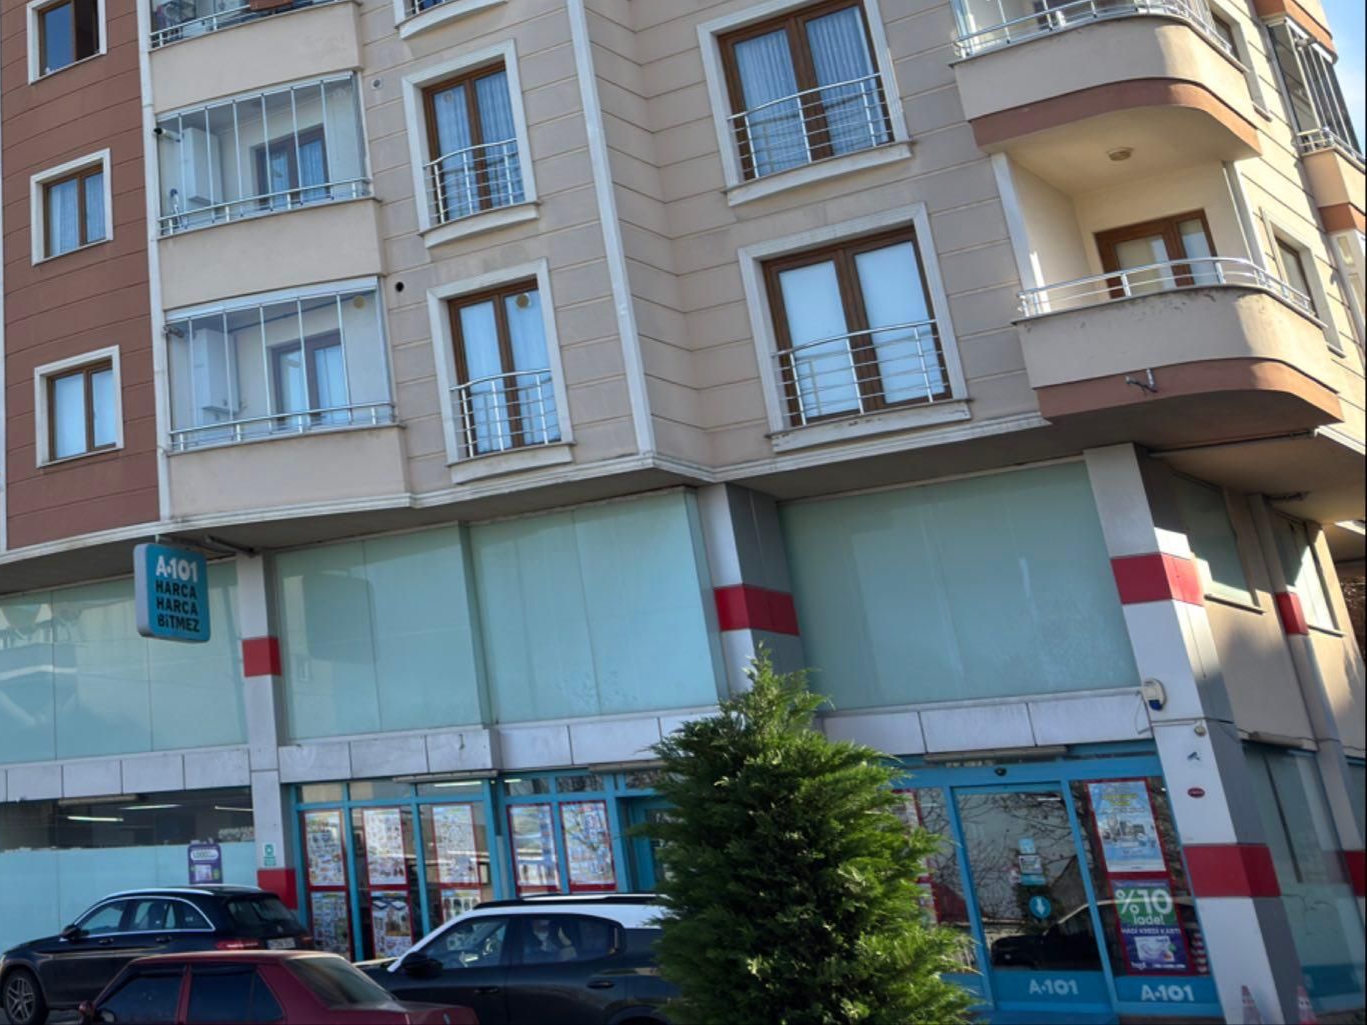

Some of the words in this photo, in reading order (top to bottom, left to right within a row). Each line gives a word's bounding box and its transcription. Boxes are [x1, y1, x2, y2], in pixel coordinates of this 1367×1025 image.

[155, 579, 198, 600] HARCA
[156, 597, 199, 616] HARCA
[1115, 888, 1173, 915] %10
